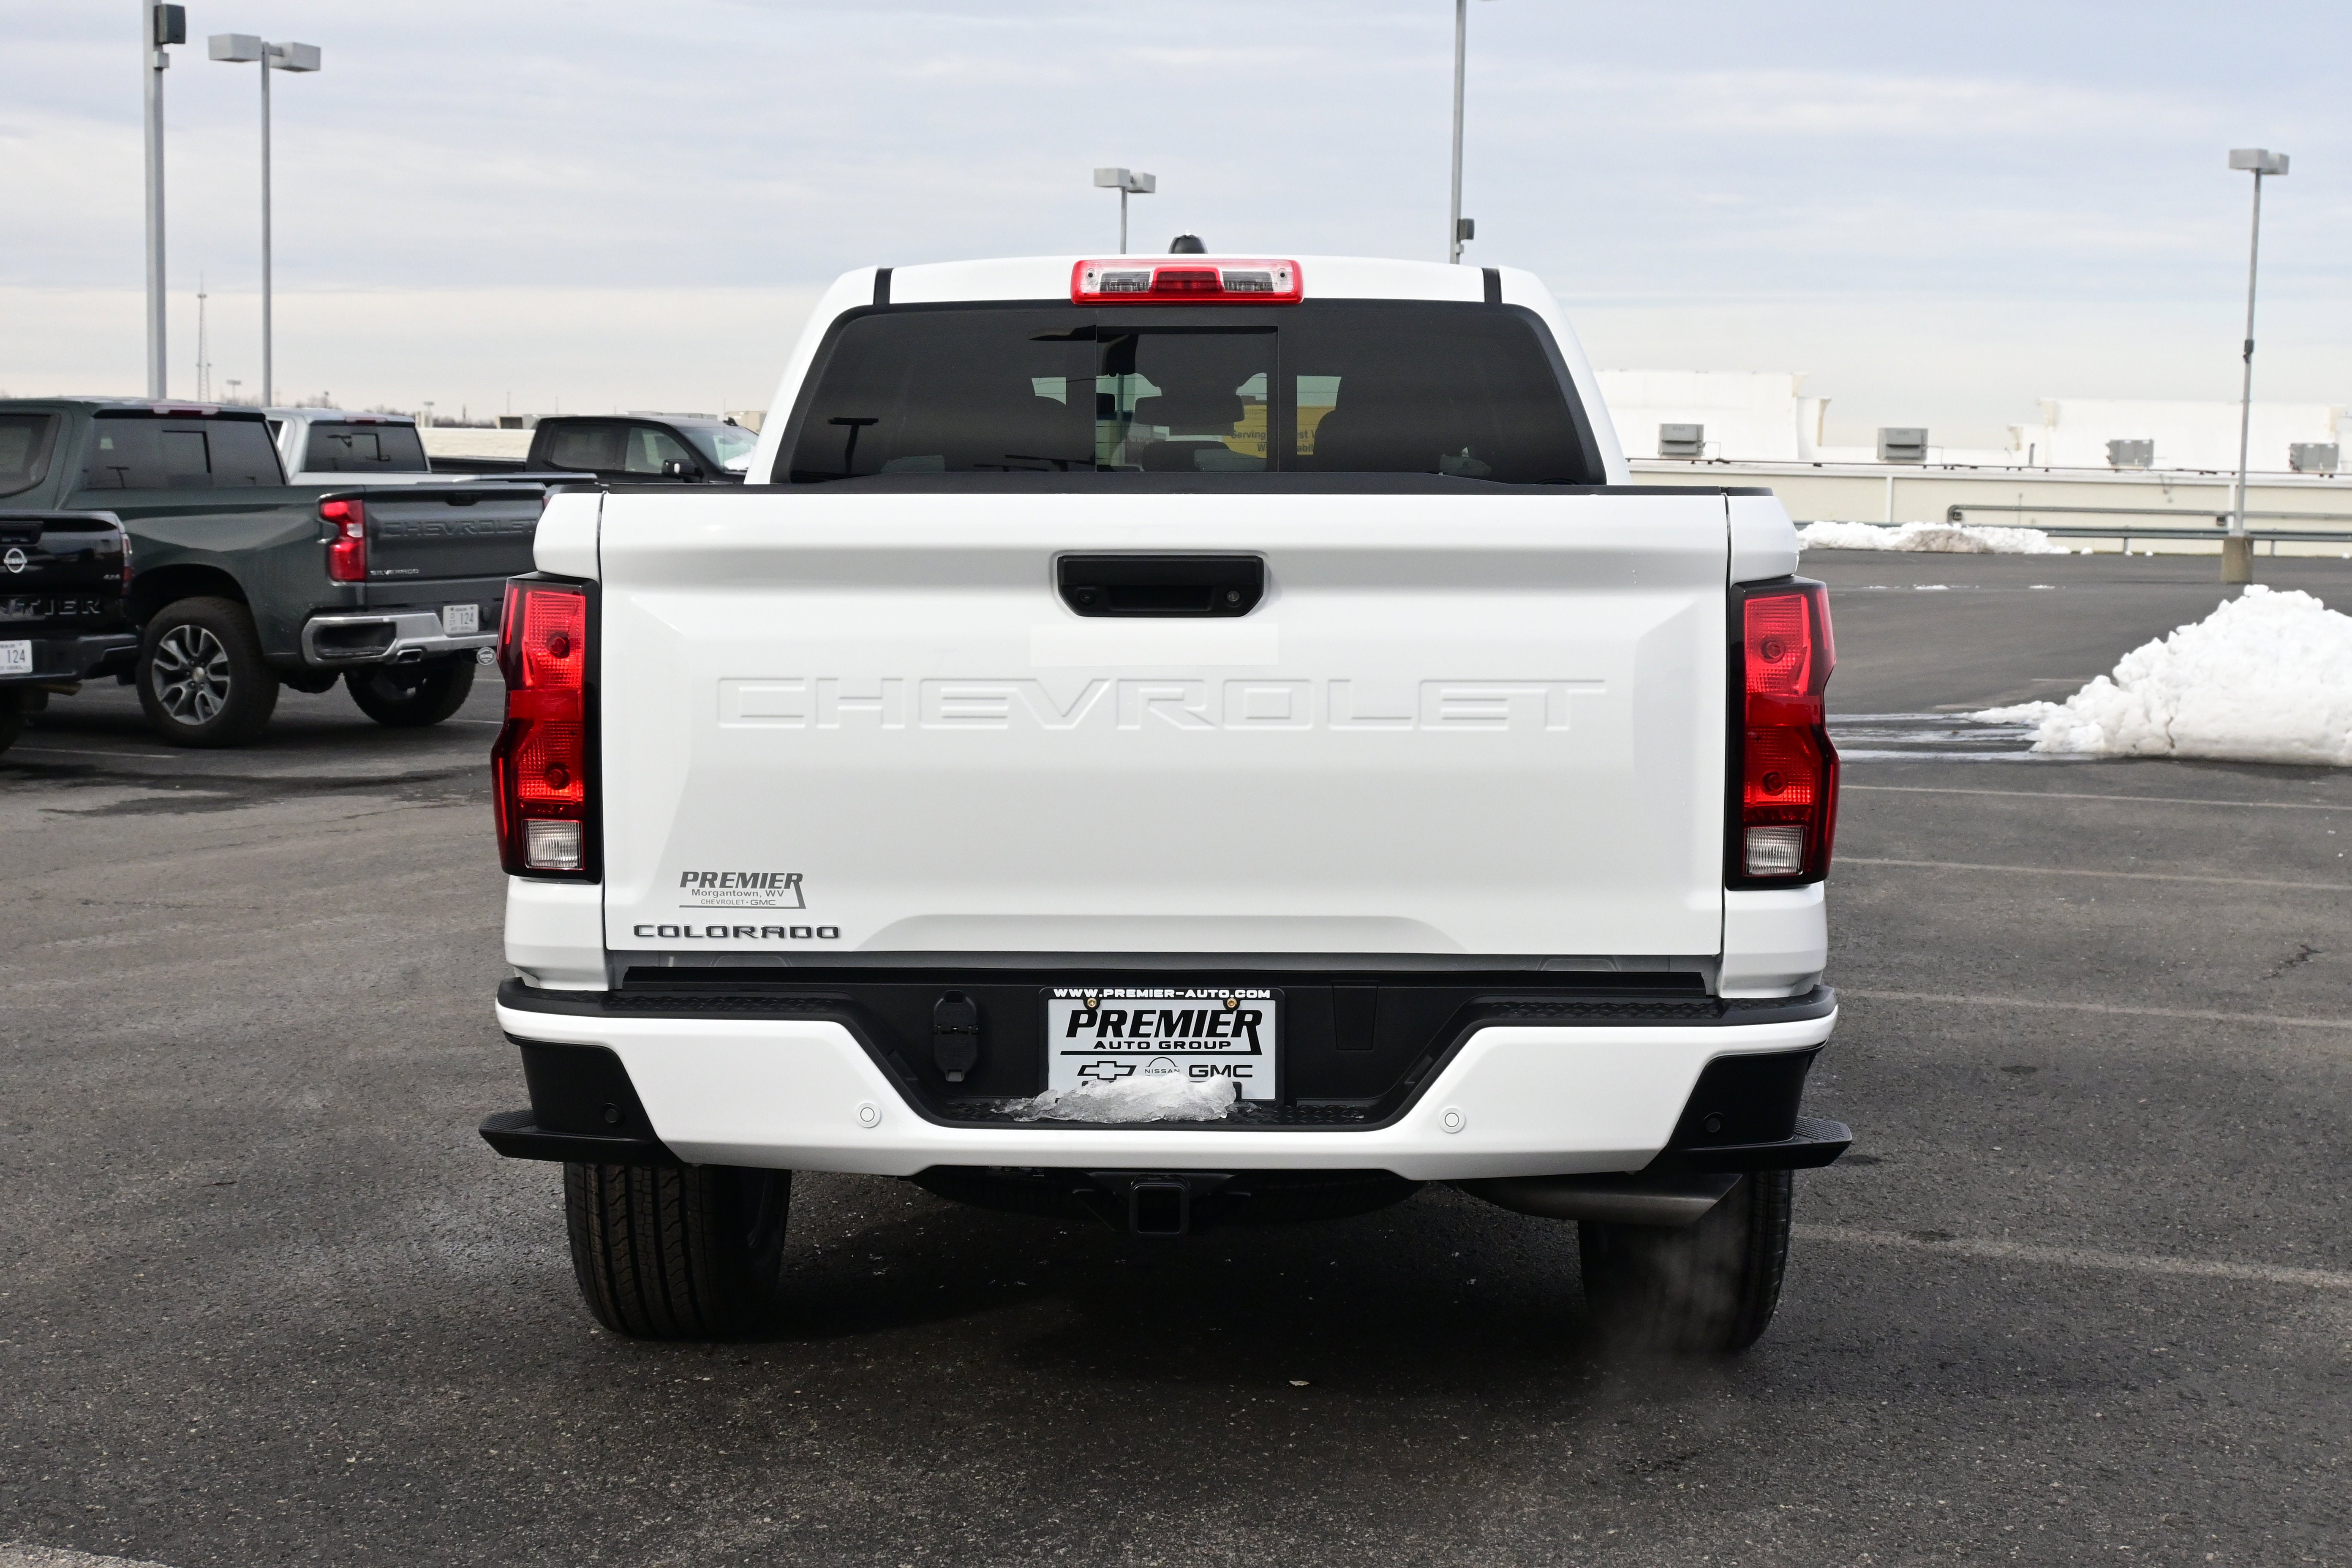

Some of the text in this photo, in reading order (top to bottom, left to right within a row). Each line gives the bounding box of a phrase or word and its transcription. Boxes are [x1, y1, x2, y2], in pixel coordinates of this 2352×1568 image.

[381, 519, 536, 537] CHEVROLET
[7, 649, 25, 663] 124
[717, 678, 1608, 730] CHEVROLET
[692, 889, 762, 898] Morgantown,
[634, 924, 840, 938] COLORADO
[1054, 989, 1270, 998] WWW.PREMIER-AUTO.COM
[1066, 1010, 1262, 1055] PREMIER
[1093, 1041, 1231, 1049] AUTO GROUP
[1189, 1065, 1253, 1078] GMC
